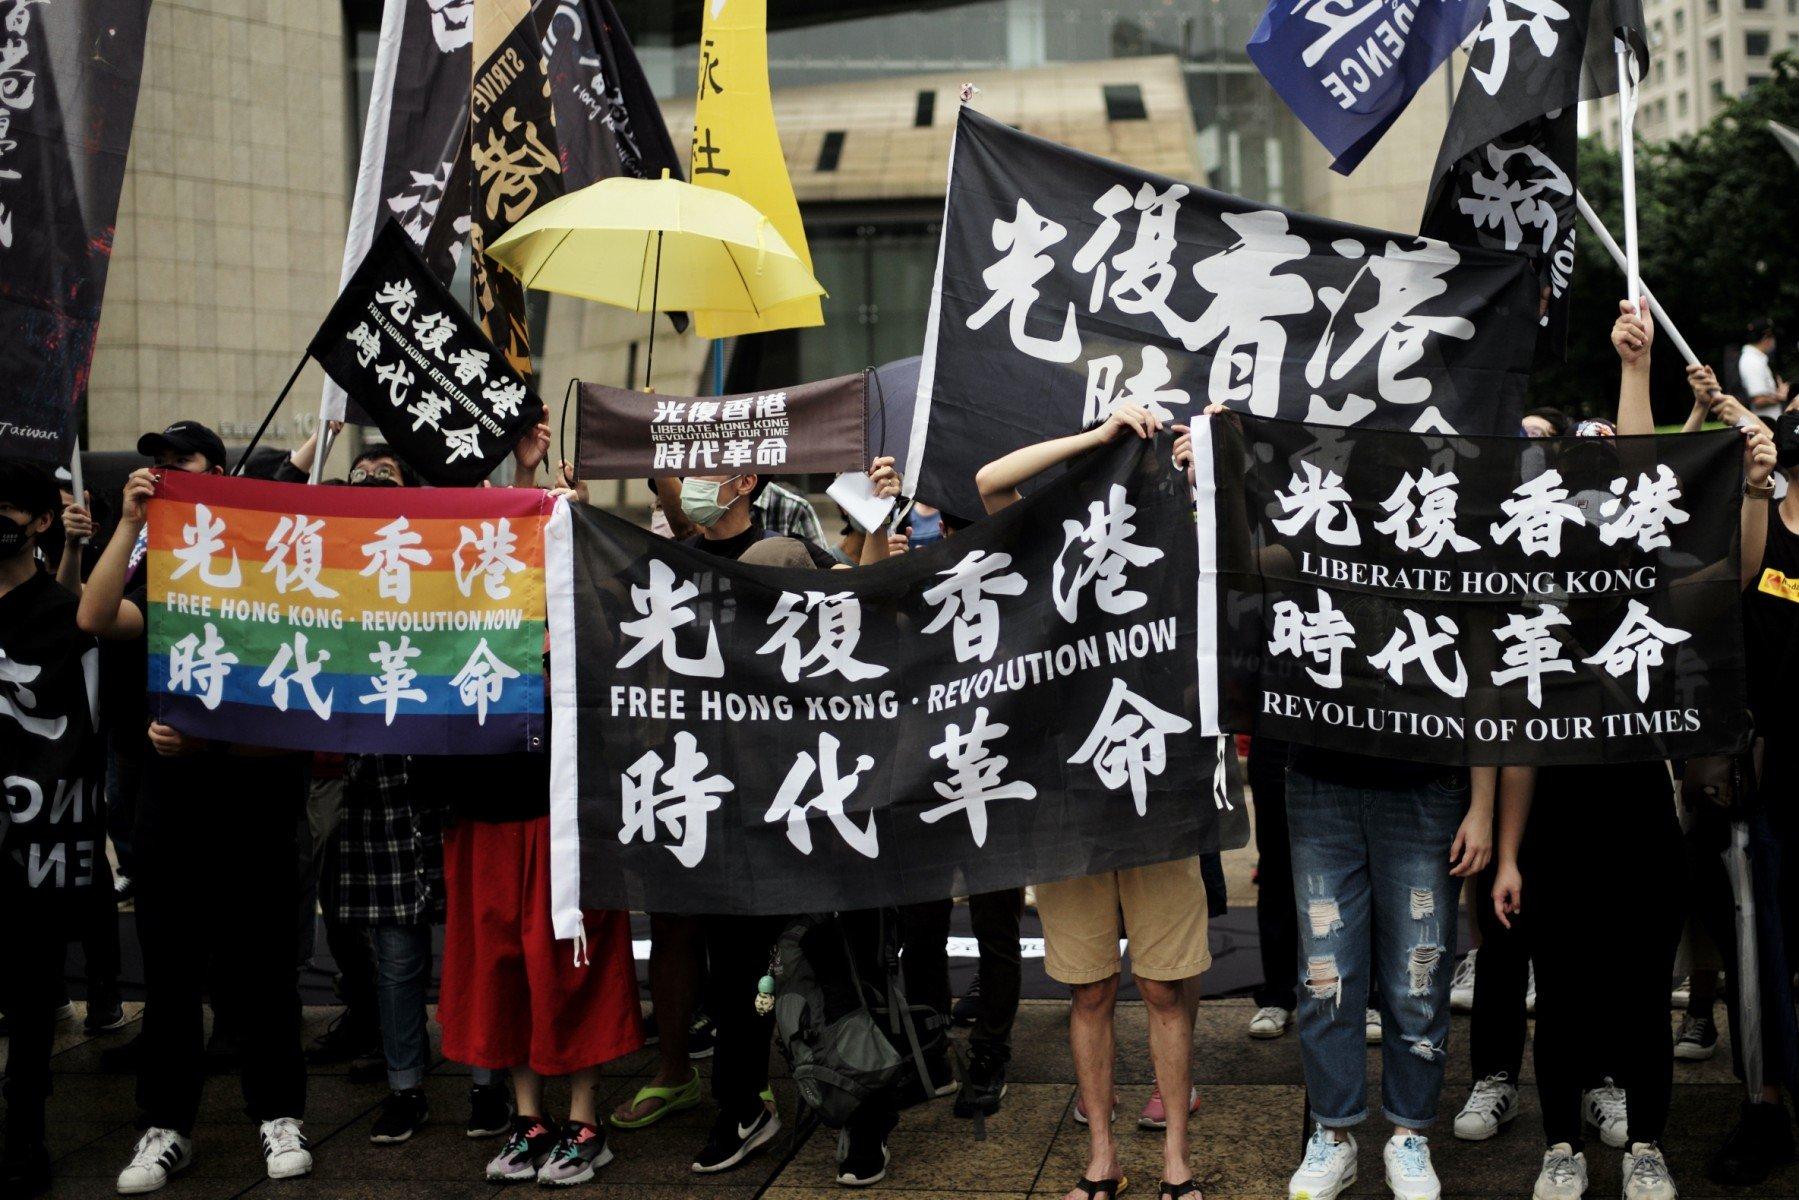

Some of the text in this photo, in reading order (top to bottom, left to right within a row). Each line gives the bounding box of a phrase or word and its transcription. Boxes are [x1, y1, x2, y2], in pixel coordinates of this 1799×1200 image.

[375, 278, 527, 419] 光復香港
[966, 183, 1475, 415] 光復香港
[346, 321, 485, 464] 時代革命
[367, 302, 505, 438] FREE HONG KONG REVOLUTION NOW
[653, 392, 789, 424] 光復香港
[651, 418, 789, 434] LIBERATE HONG KONG
[651, 427, 789, 441] REVOLUTION OF OUR TIME
[653, 438, 788, 469] 時代革命
[169, 503, 526, 604] 光復香港
[1272, 459, 1691, 558] 光復香港
[167, 592, 523, 631] FREE HONG KONG REVOLUTION NOW
[615, 483, 1165, 683] 光復香港
[1301, 551, 1658, 595] LIBERATE HONG KONG
[166, 622, 521, 726] 時代革命
[611, 616, 1178, 721] FREE HONG KONG REVOLUTION NOW
[1268, 588, 1692, 708] 時代革命
[1262, 690, 1700, 742] REVOLUTION OF OUR TIMES
[618, 677, 1192, 868] 時代革命
